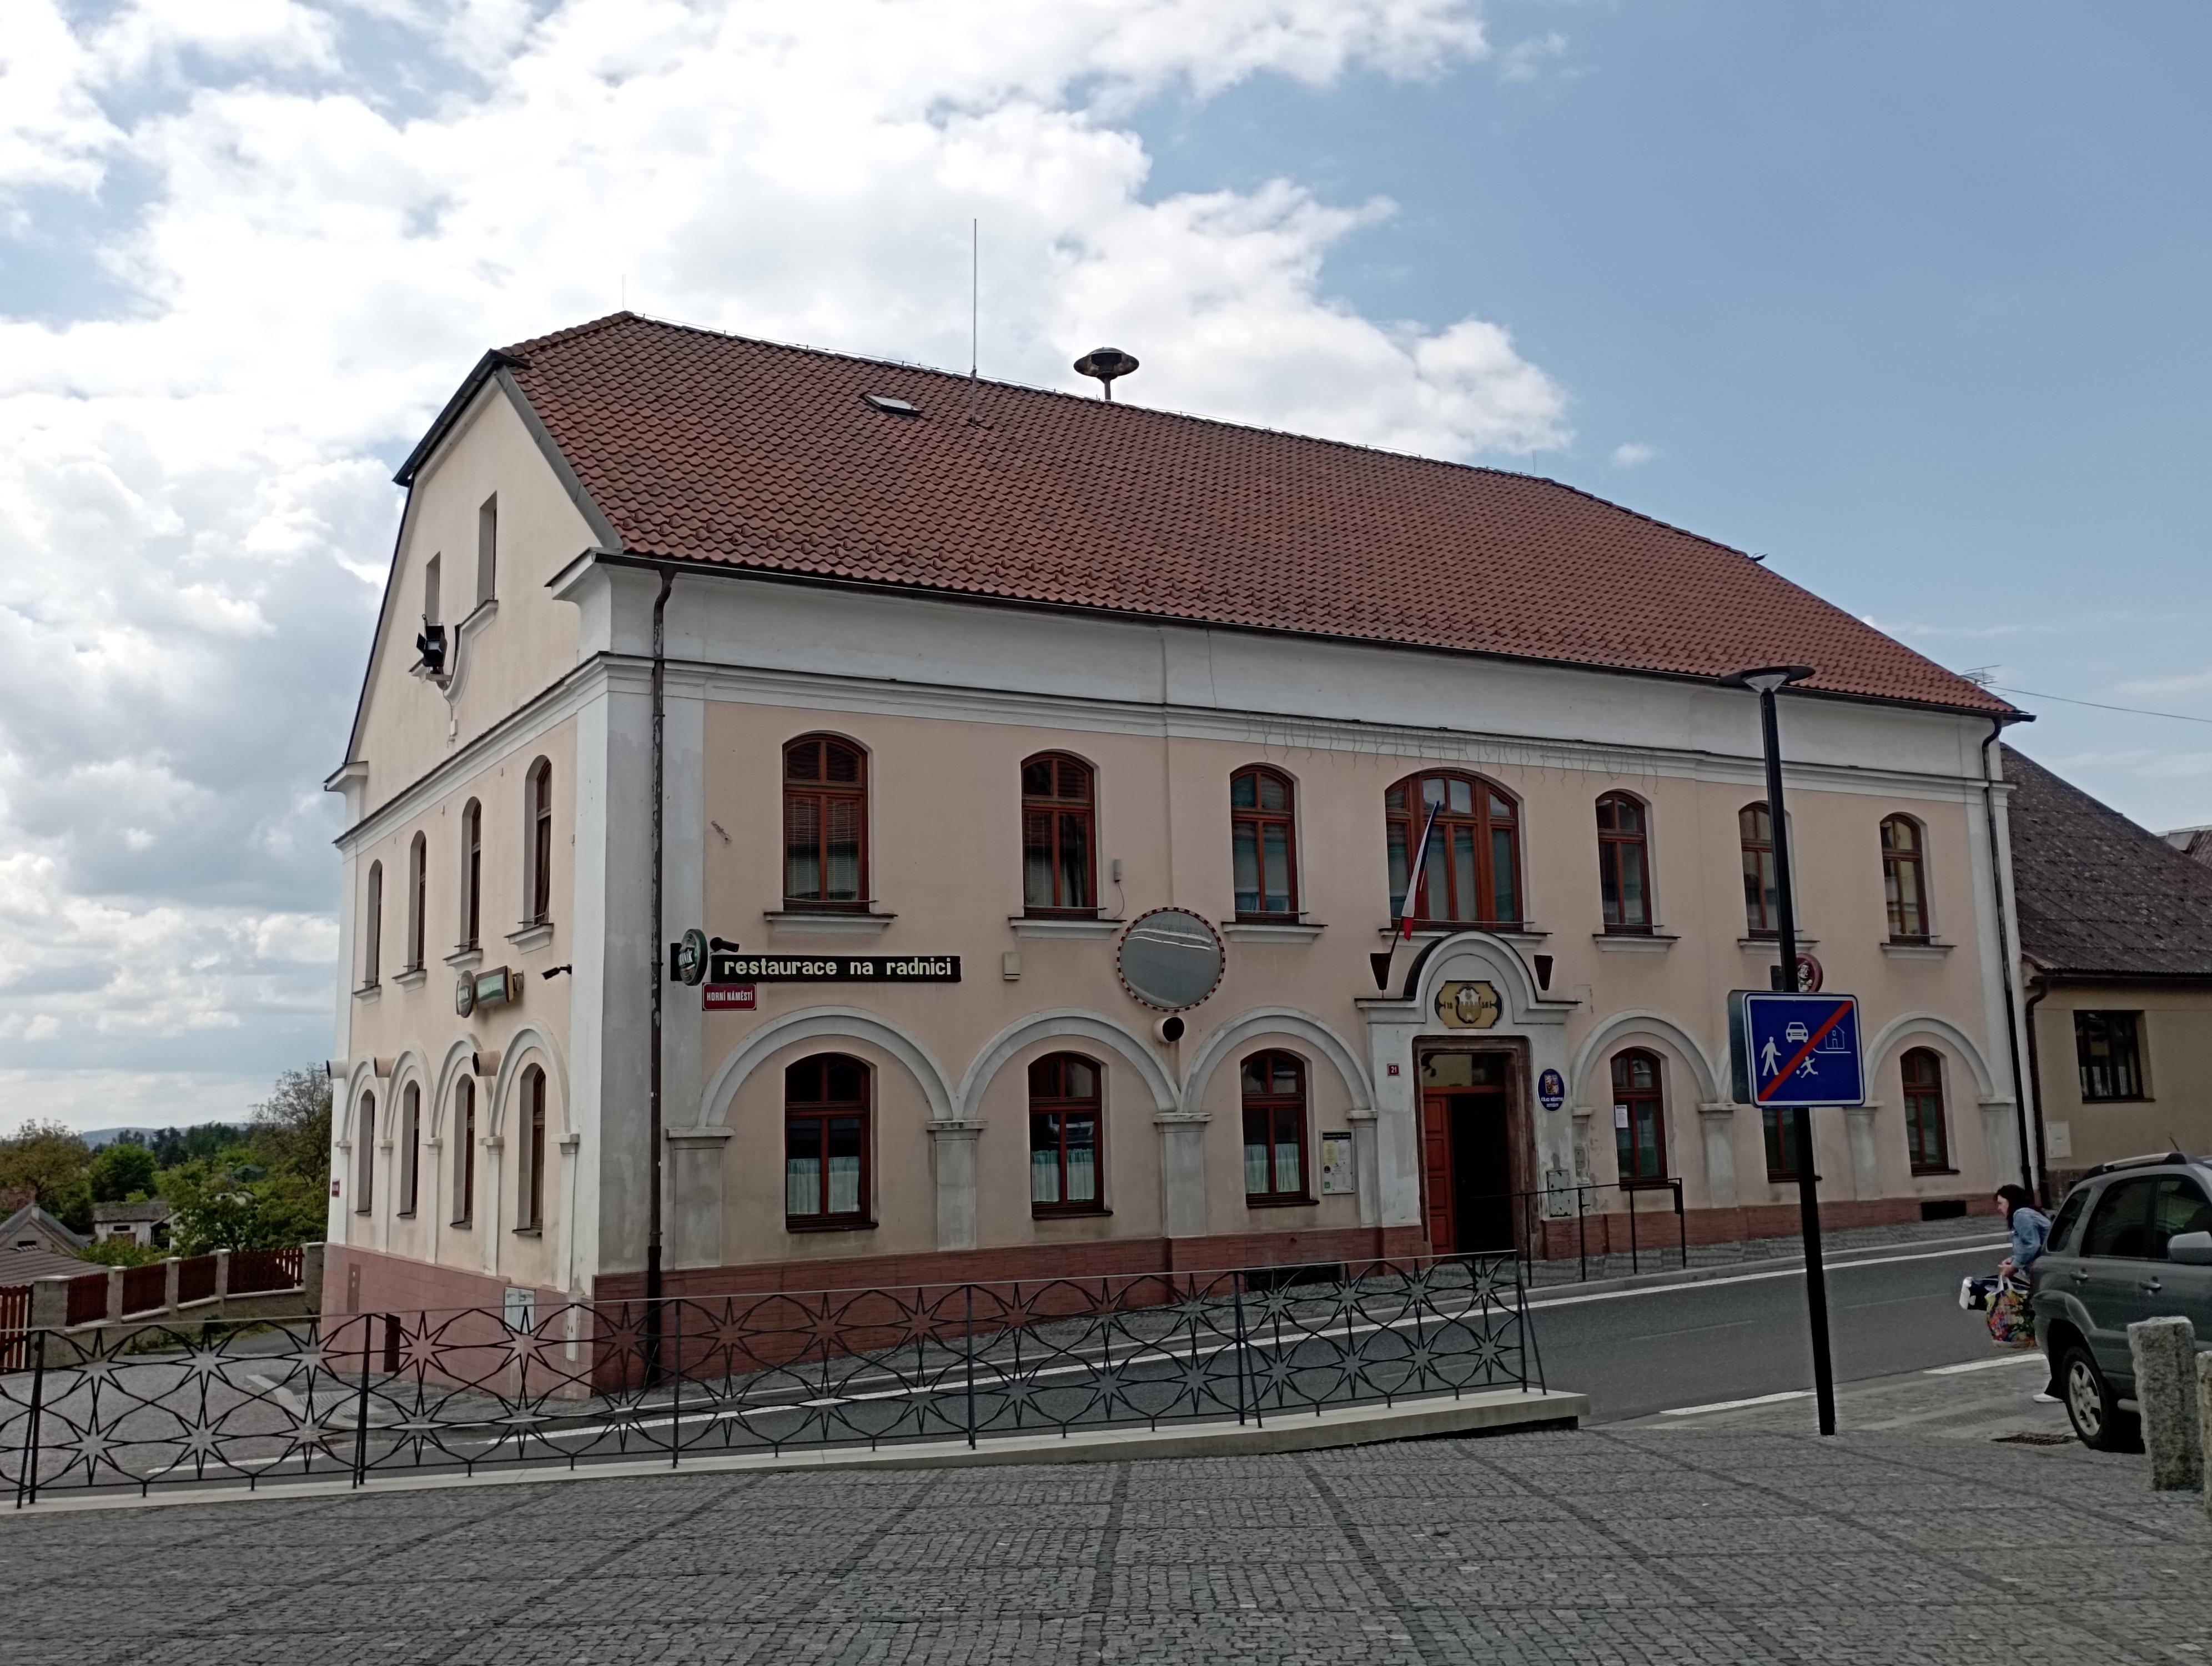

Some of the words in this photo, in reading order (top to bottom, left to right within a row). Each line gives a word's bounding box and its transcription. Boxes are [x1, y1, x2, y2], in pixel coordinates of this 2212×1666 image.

[724, 958, 837, 975] restaurace
[850, 961, 873, 975] na
[886, 957, 951, 975] radnici
[707, 990, 726, 1001] HORNÍ
[727, 990, 753, 1001] NÁMĚSTÍ
